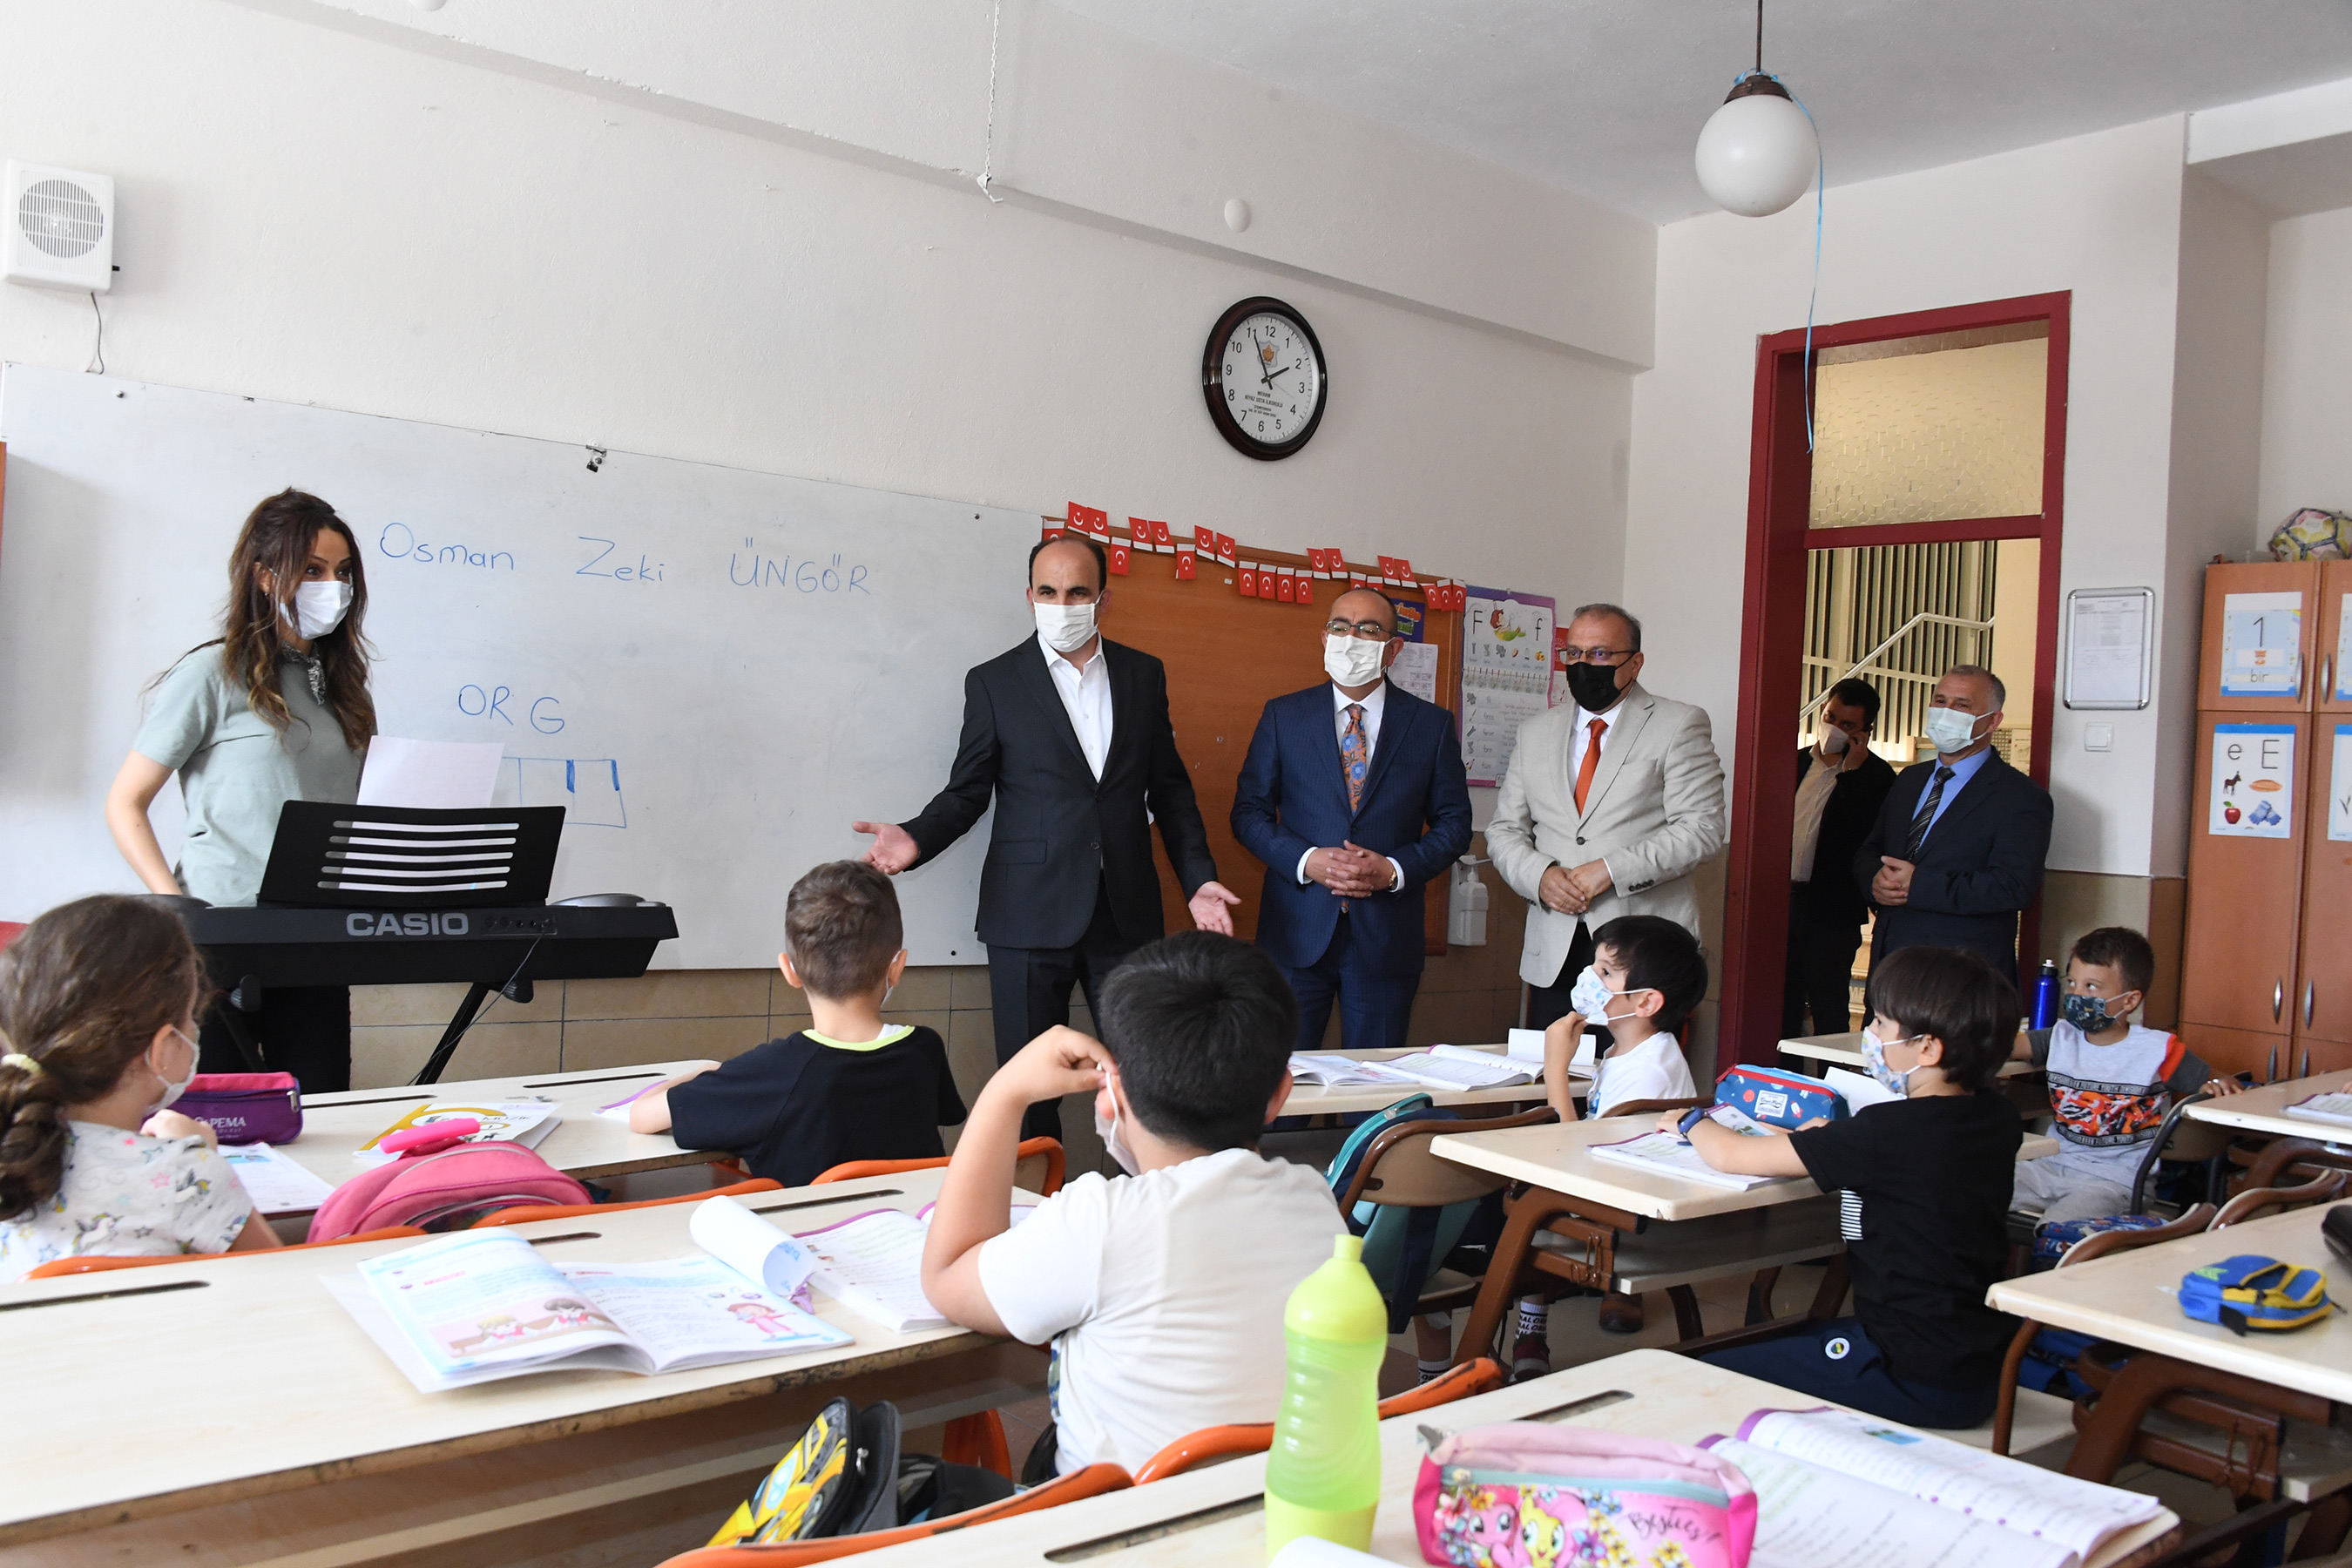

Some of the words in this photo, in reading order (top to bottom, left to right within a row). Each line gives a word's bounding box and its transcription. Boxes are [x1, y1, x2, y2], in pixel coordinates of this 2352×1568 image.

[1265, 325, 1276, 338] 12
[1231, 341, 1242, 354] 10
[1285, 337, 1290, 349] 1
[1226, 364, 1233, 376] 9
[1295, 358, 1302, 370] 2
[1298, 382, 1305, 394] 3
[1228, 389, 1235, 402] 8
[1240, 409, 1247, 422] 7
[1290, 404, 1297, 416] 4
[1258, 421, 1265, 432] 6
[1275, 419, 1282, 430] 5
[380, 523, 514, 571] Osman
[576, 536, 665, 582] Zeki
[730, 537, 871, 595] ÜNGÖR
[1473, 610, 1483, 635] F
[1535, 618, 1543, 641] f
[2253, 616, 2264, 647] 1
[2250, 669, 2268, 683] bir
[2227, 743, 2242, 760] e
[2261, 740, 2280, 769] E
[346, 913, 470, 936] CASIO
